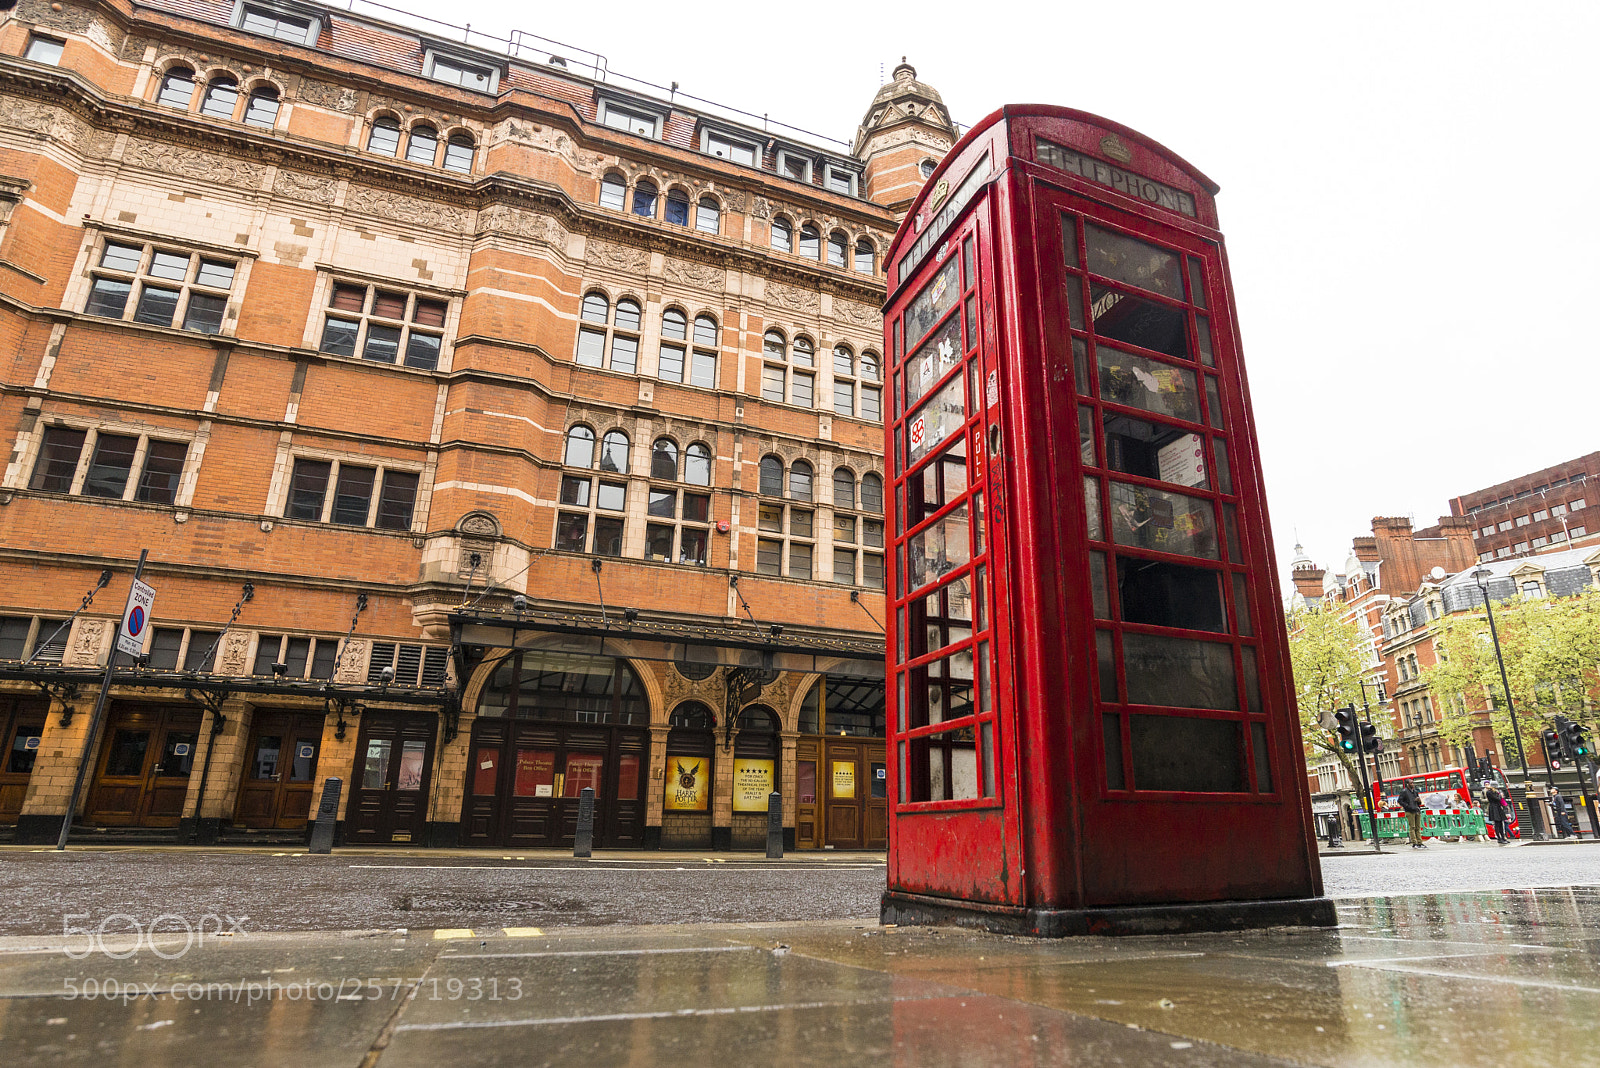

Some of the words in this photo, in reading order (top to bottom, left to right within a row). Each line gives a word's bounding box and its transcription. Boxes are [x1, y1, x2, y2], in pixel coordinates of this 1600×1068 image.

[1042, 144, 1190, 215] TELEPHONE
[134, 582, 155, 599] Controlled
[134, 592, 149, 607] ZONE
